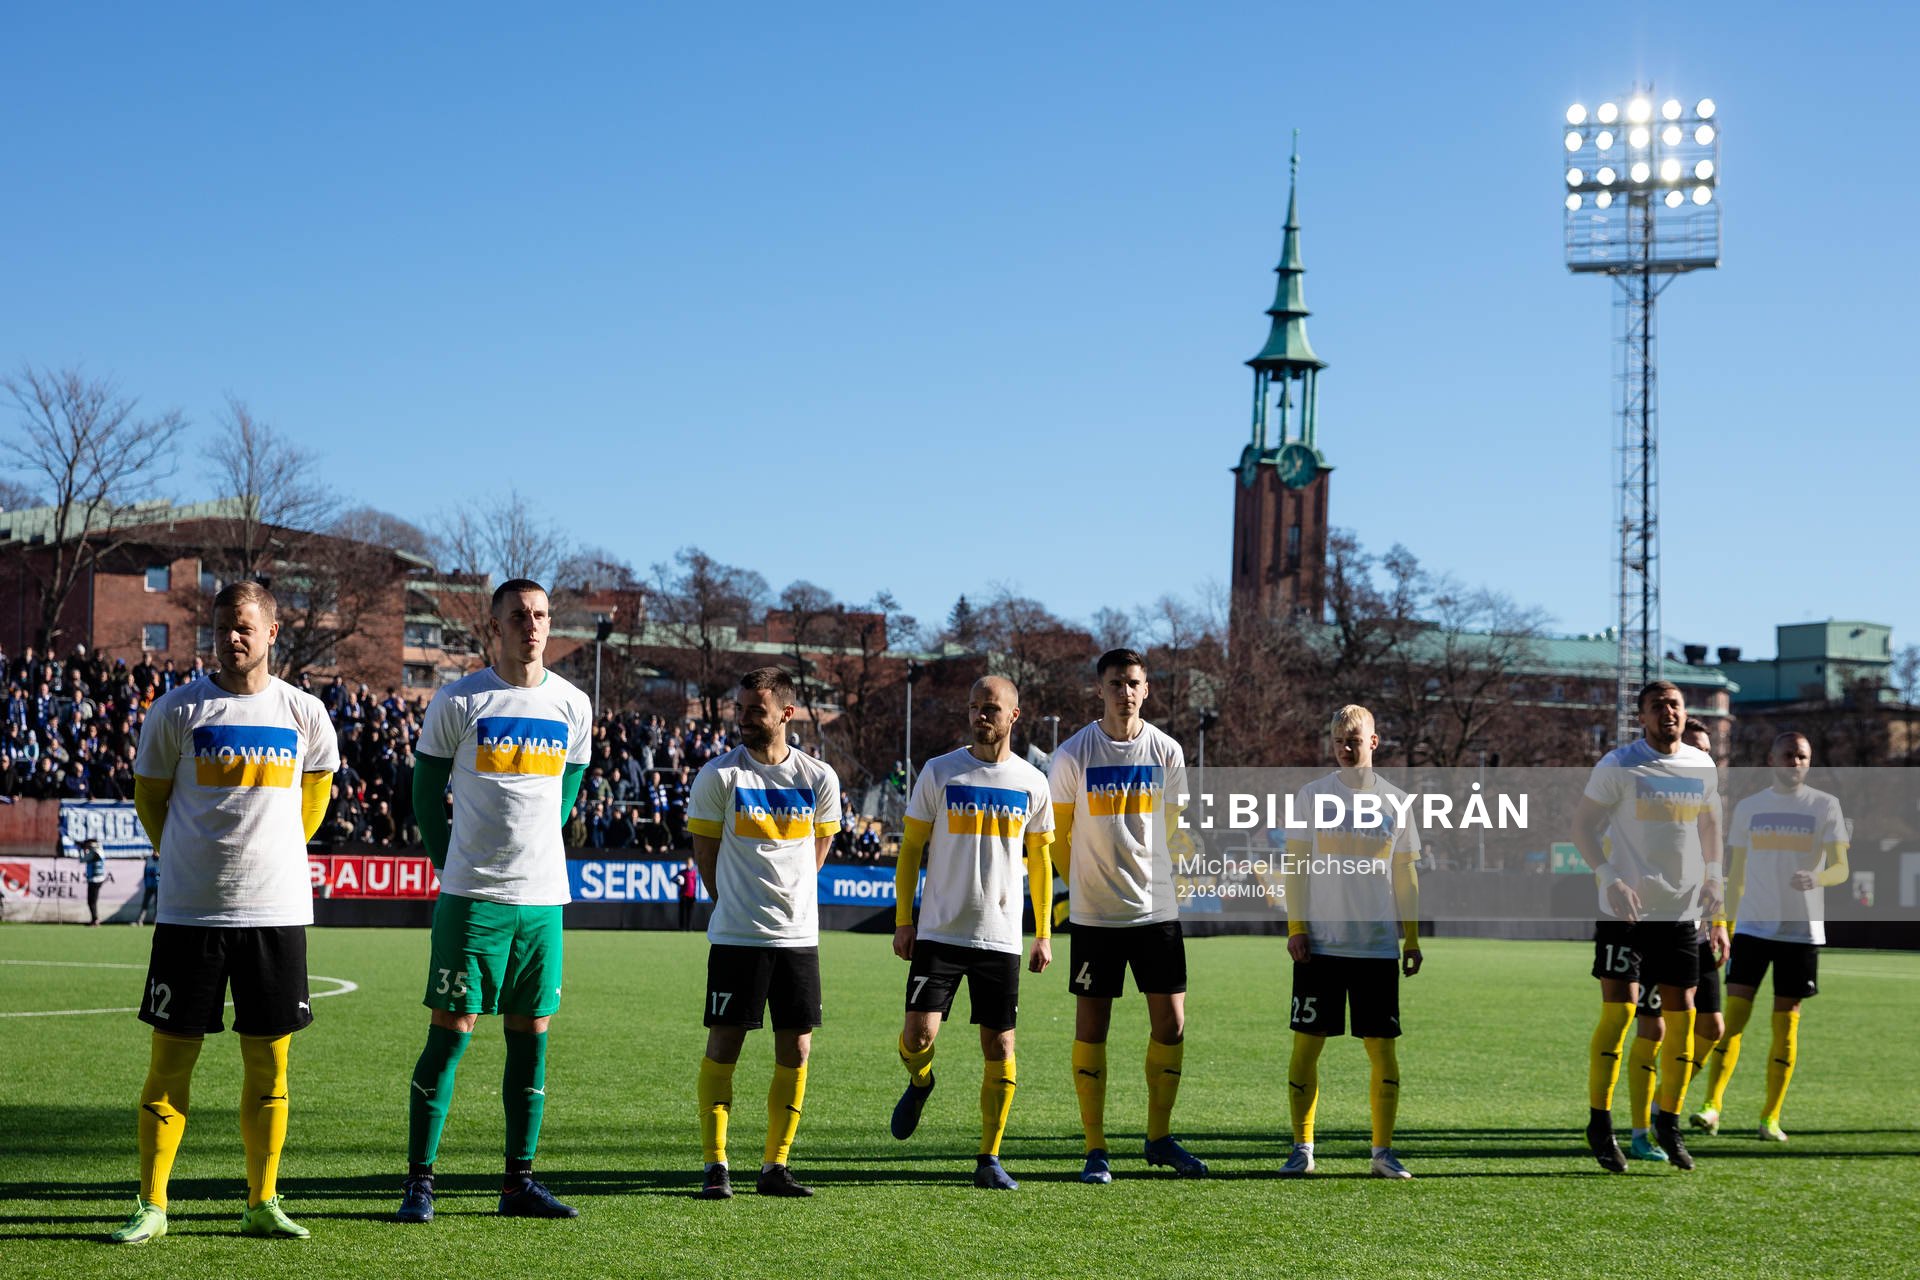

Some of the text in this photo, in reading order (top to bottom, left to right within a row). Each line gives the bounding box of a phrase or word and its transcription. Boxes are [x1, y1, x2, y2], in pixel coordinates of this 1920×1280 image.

[200, 745, 293, 767] NO WAR
[483, 735, 564, 758] NO WAR
[1091, 781, 1161, 799] NO WAR
[1668, 791, 1703, 806] WAR
[740, 804, 813, 822] NO WAR
[951, 801, 1024, 822] NO WAR
[37, 886, 78, 899] SPEL
[581, 862, 709, 900] SERN
[834, 875, 897, 899] morri
[1605, 944, 1632, 973] 15
[436, 968, 469, 998] 35
[1075, 961, 1093, 991] 4
[149, 976, 172, 1020] 12
[911, 975, 930, 1004] 7
[1638, 984, 1662, 1010] 26
[711, 991, 733, 1016] 17
[1292, 996, 1318, 1023] 25
